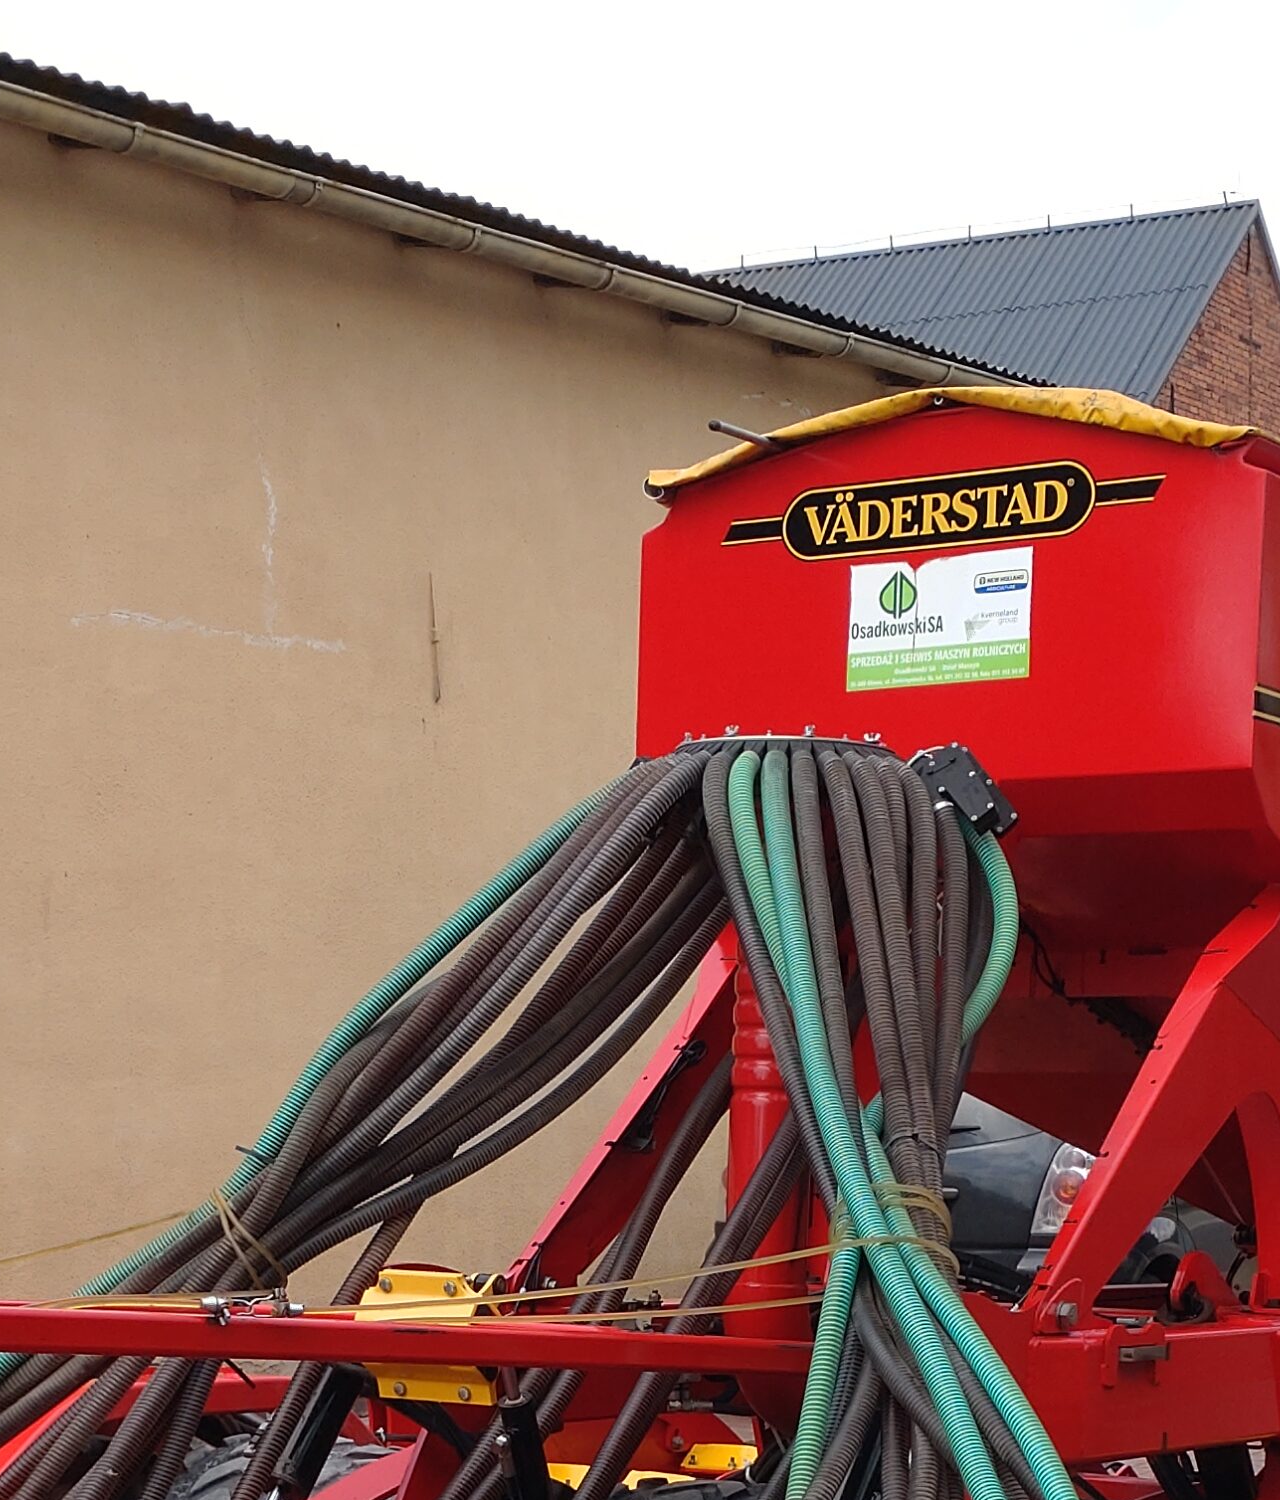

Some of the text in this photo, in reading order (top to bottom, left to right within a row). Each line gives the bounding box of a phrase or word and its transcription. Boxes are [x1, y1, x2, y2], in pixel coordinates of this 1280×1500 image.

[803, 479, 1069, 546] VÄDERSTAD
[850, 652, 894, 668] SPRZEDAŻ
[900, 650, 933, 664] SERWIS
[934, 647, 971, 660] MASZYN
[972, 643, 1026, 657] ROLNICZYCH
